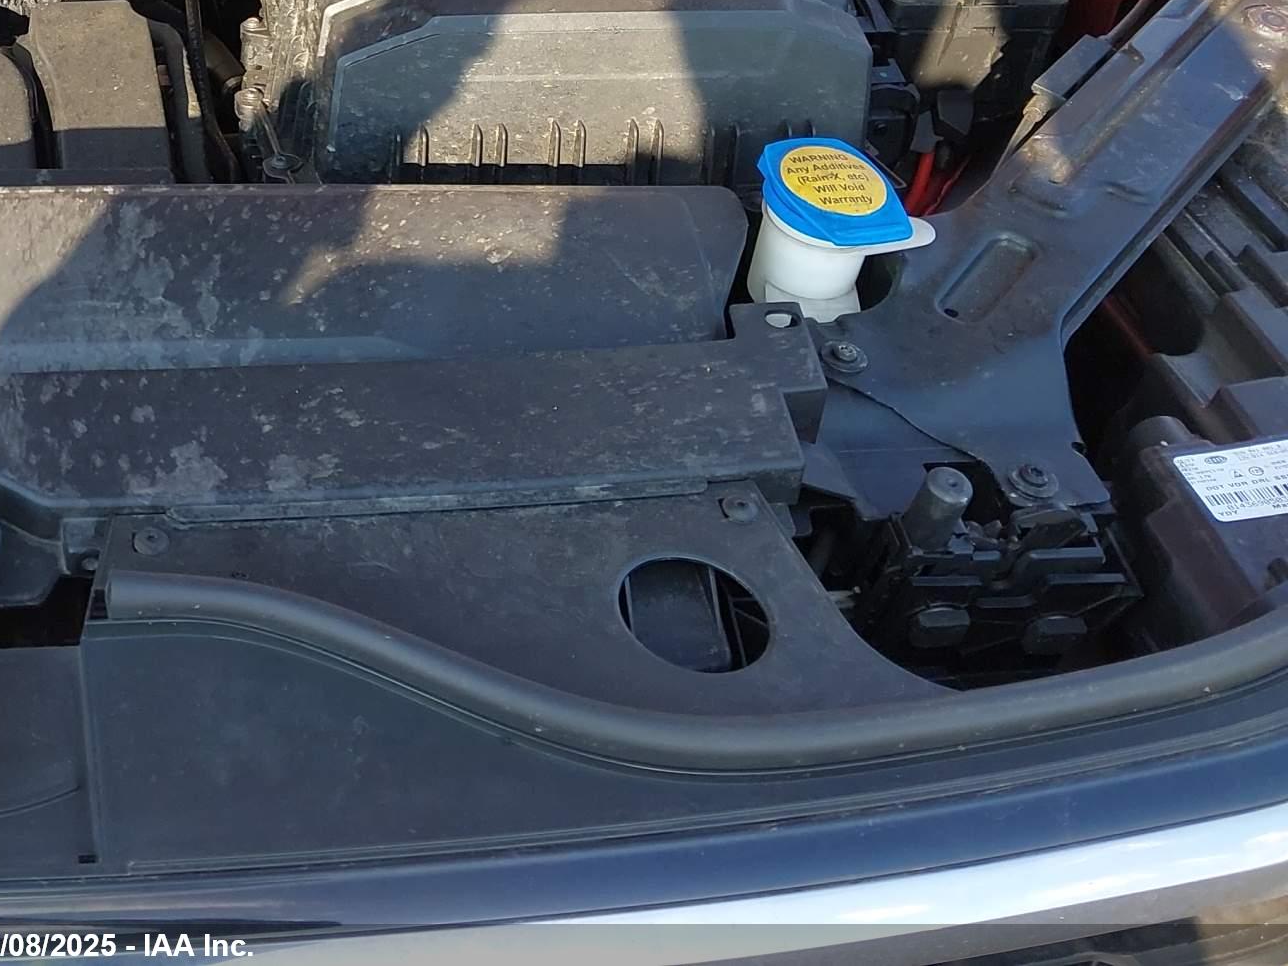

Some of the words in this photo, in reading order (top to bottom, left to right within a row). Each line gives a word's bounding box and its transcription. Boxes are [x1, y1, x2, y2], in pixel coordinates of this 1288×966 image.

[789, 154, 848, 163] WARNING
[787, 166, 810, 175] Any
[813, 163, 866, 171] Additives
[847, 172, 870, 182] etc)
[813, 184, 838, 194] Will
[840, 183, 866, 192] Void
[819, 194, 873, 206] Warranty
